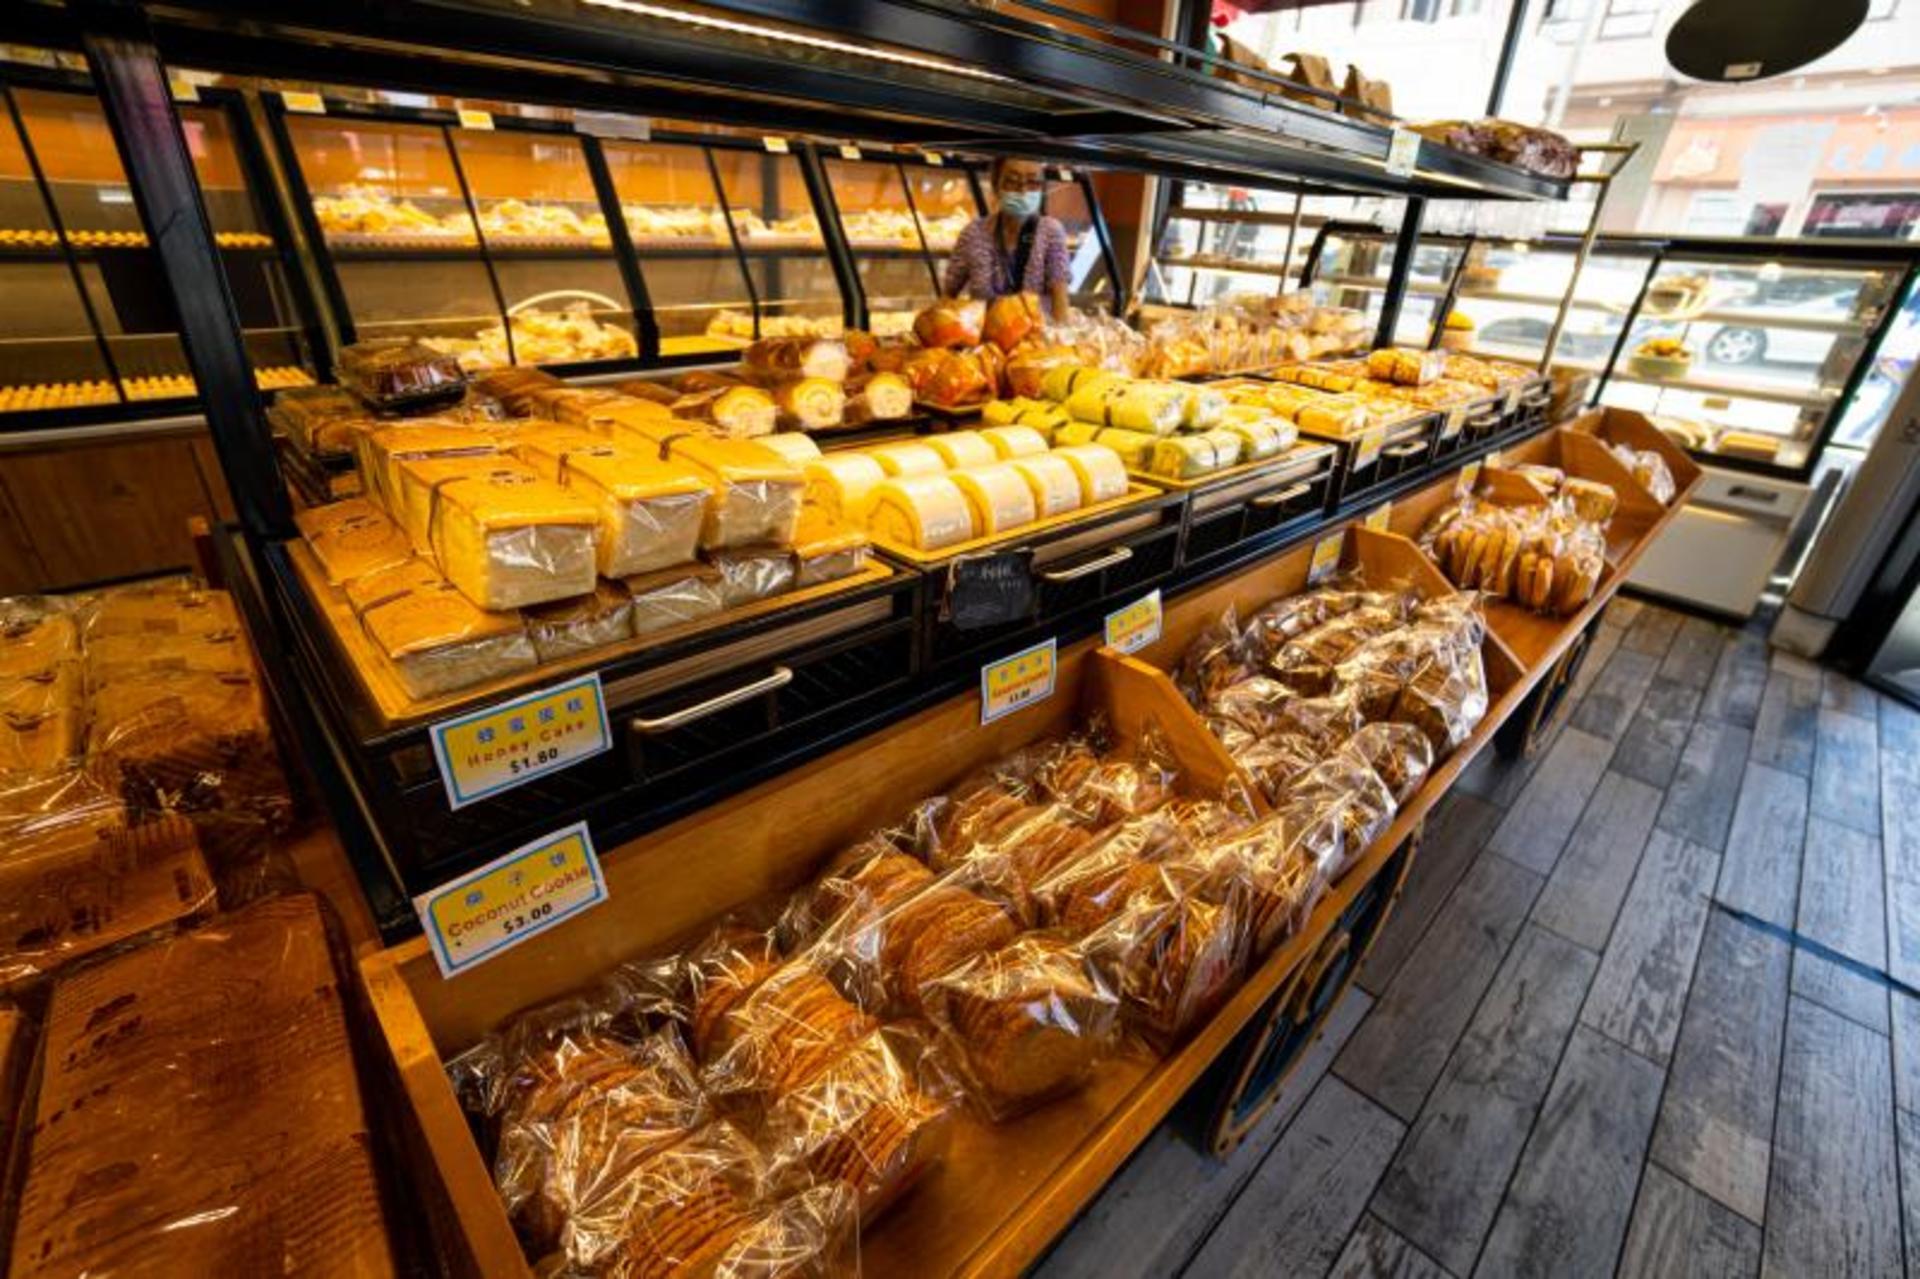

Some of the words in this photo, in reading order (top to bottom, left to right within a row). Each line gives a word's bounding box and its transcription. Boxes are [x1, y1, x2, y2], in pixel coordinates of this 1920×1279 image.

[467, 741, 529, 768] Honey
[540, 721, 584, 742] Cake
[448, 894, 528, 937] Coconut
[530, 865, 588, 900] Cookie
[503, 903, 552, 934] $3.00
